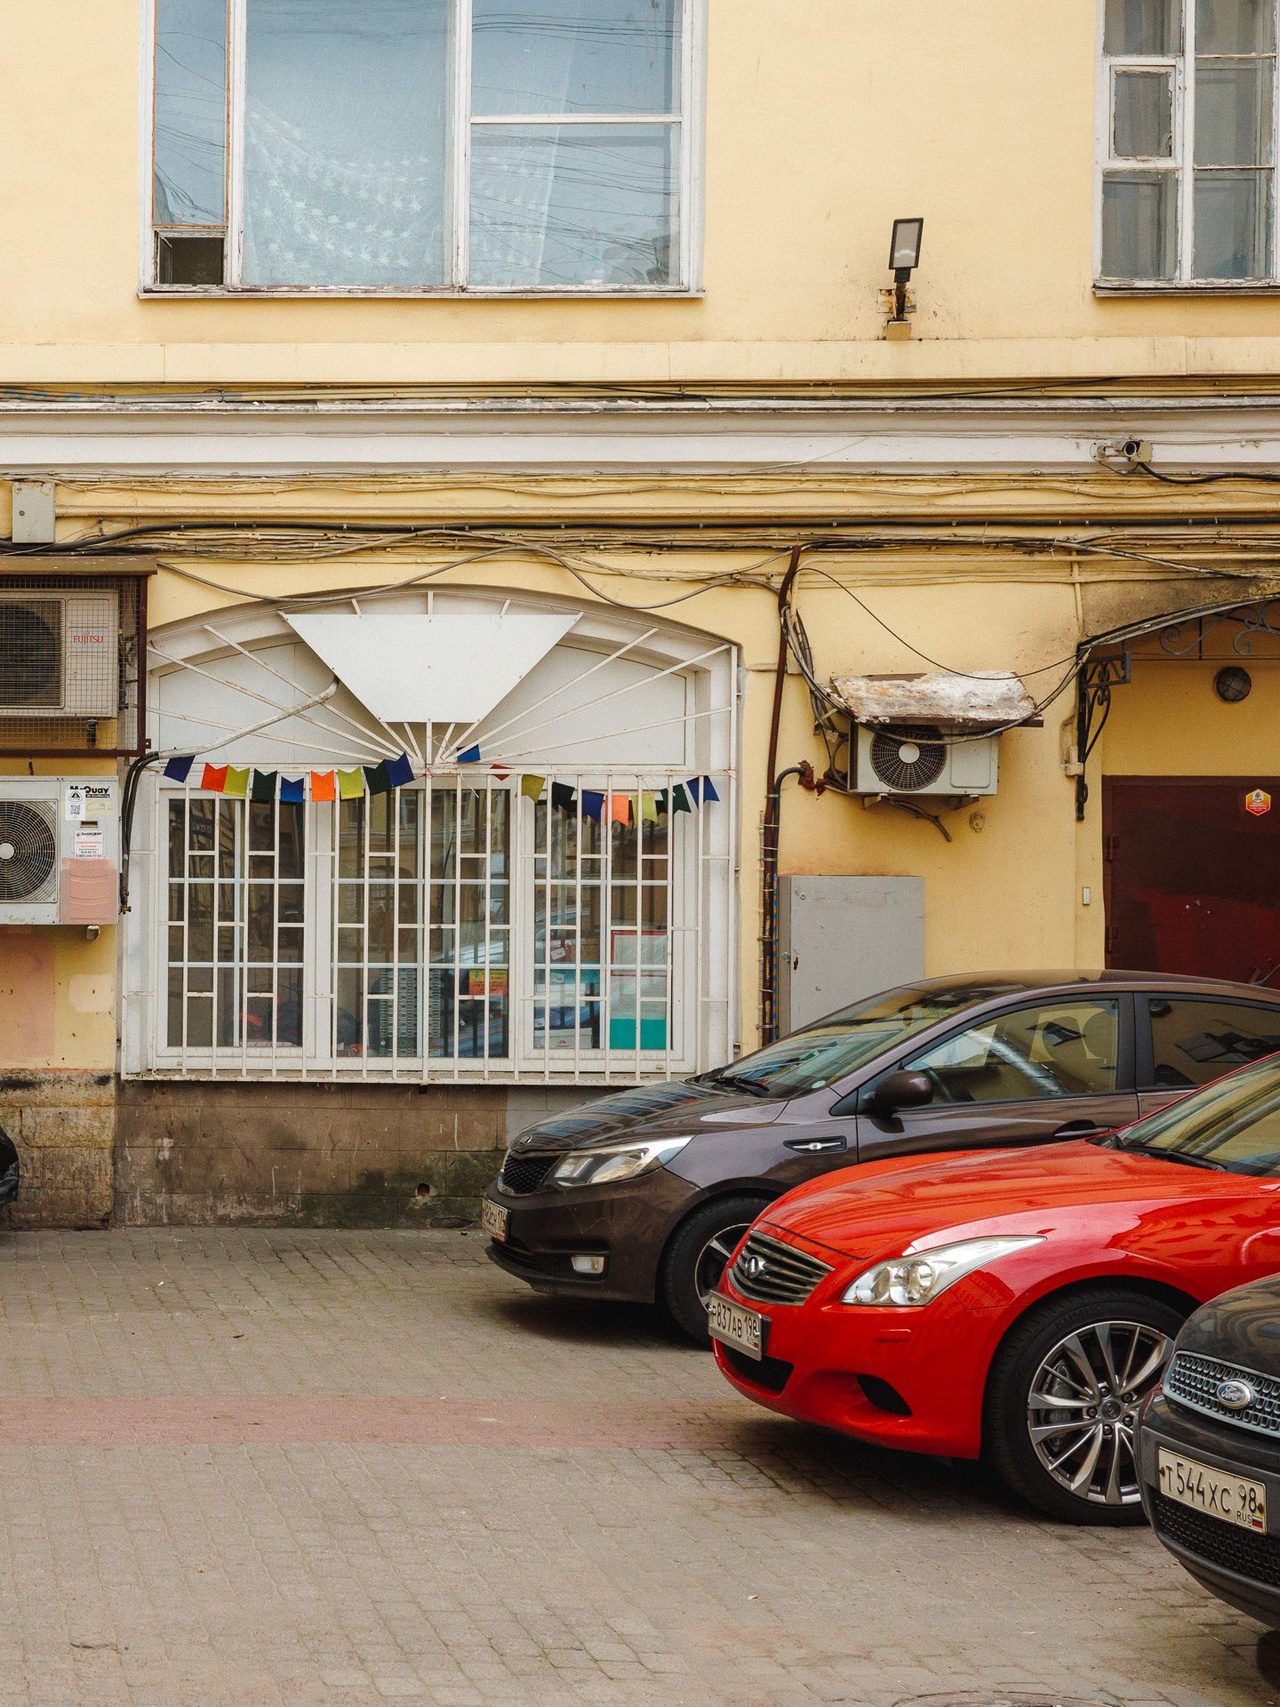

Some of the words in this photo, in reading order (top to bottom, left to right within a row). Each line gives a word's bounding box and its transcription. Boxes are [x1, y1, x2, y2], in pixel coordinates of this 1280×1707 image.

[73, 634, 104, 645] FUJITSU
[1166, 1461, 1231, 1513] T544XC
[1238, 1483, 1257, 1513] 98
[1236, 1511, 1252, 1524] RUS
